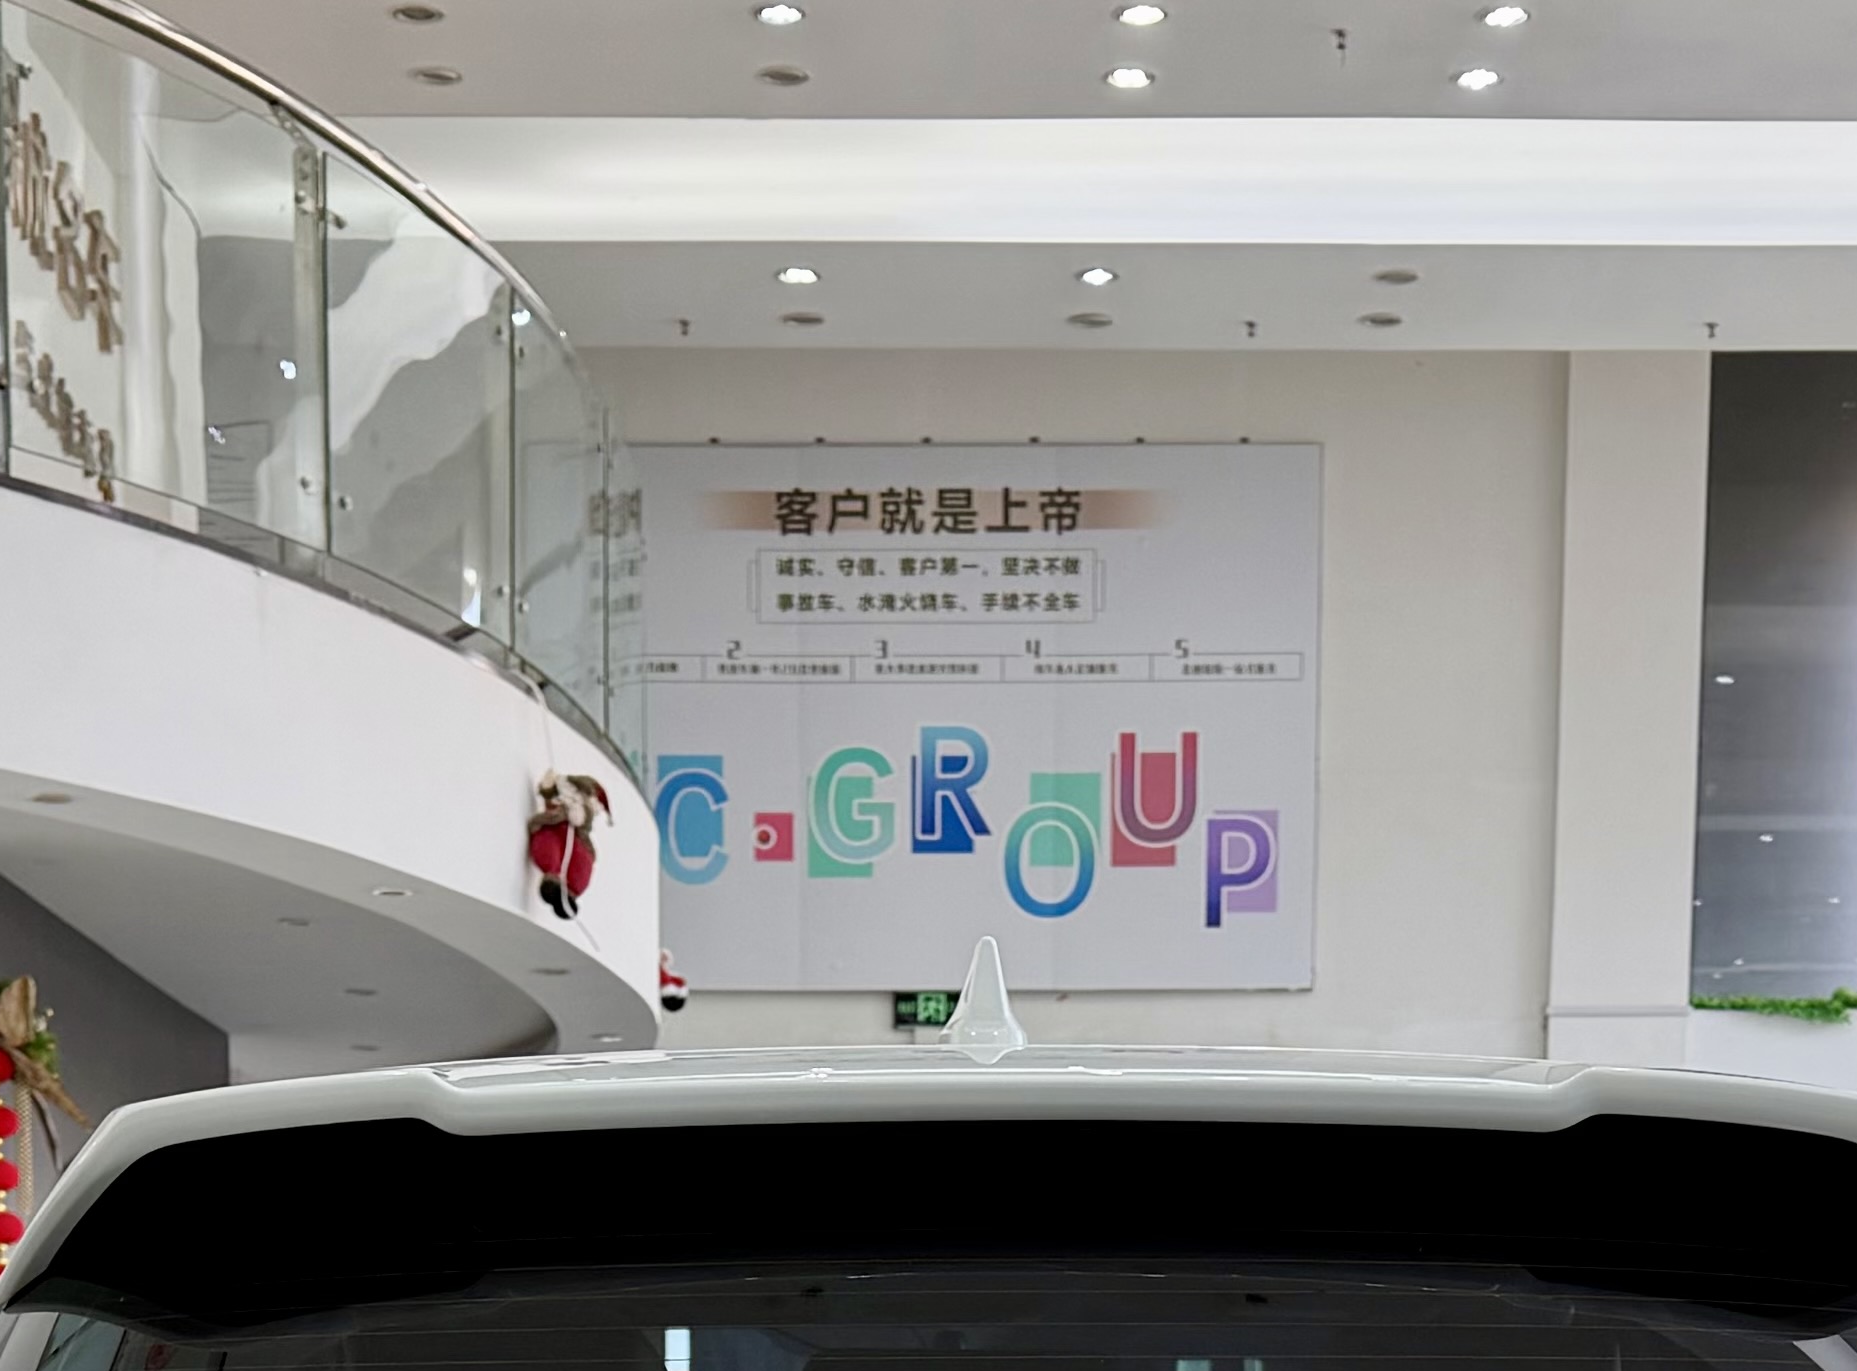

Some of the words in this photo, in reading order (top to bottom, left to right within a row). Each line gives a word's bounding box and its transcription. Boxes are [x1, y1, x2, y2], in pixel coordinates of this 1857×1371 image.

[774, 487, 1082, 535] 客户就是上帝
[726, 640, 742, 660] 2
[875, 639, 889, 660] 3
[1025, 639, 1041, 659] 4
[1174, 639, 1190, 659] 5
